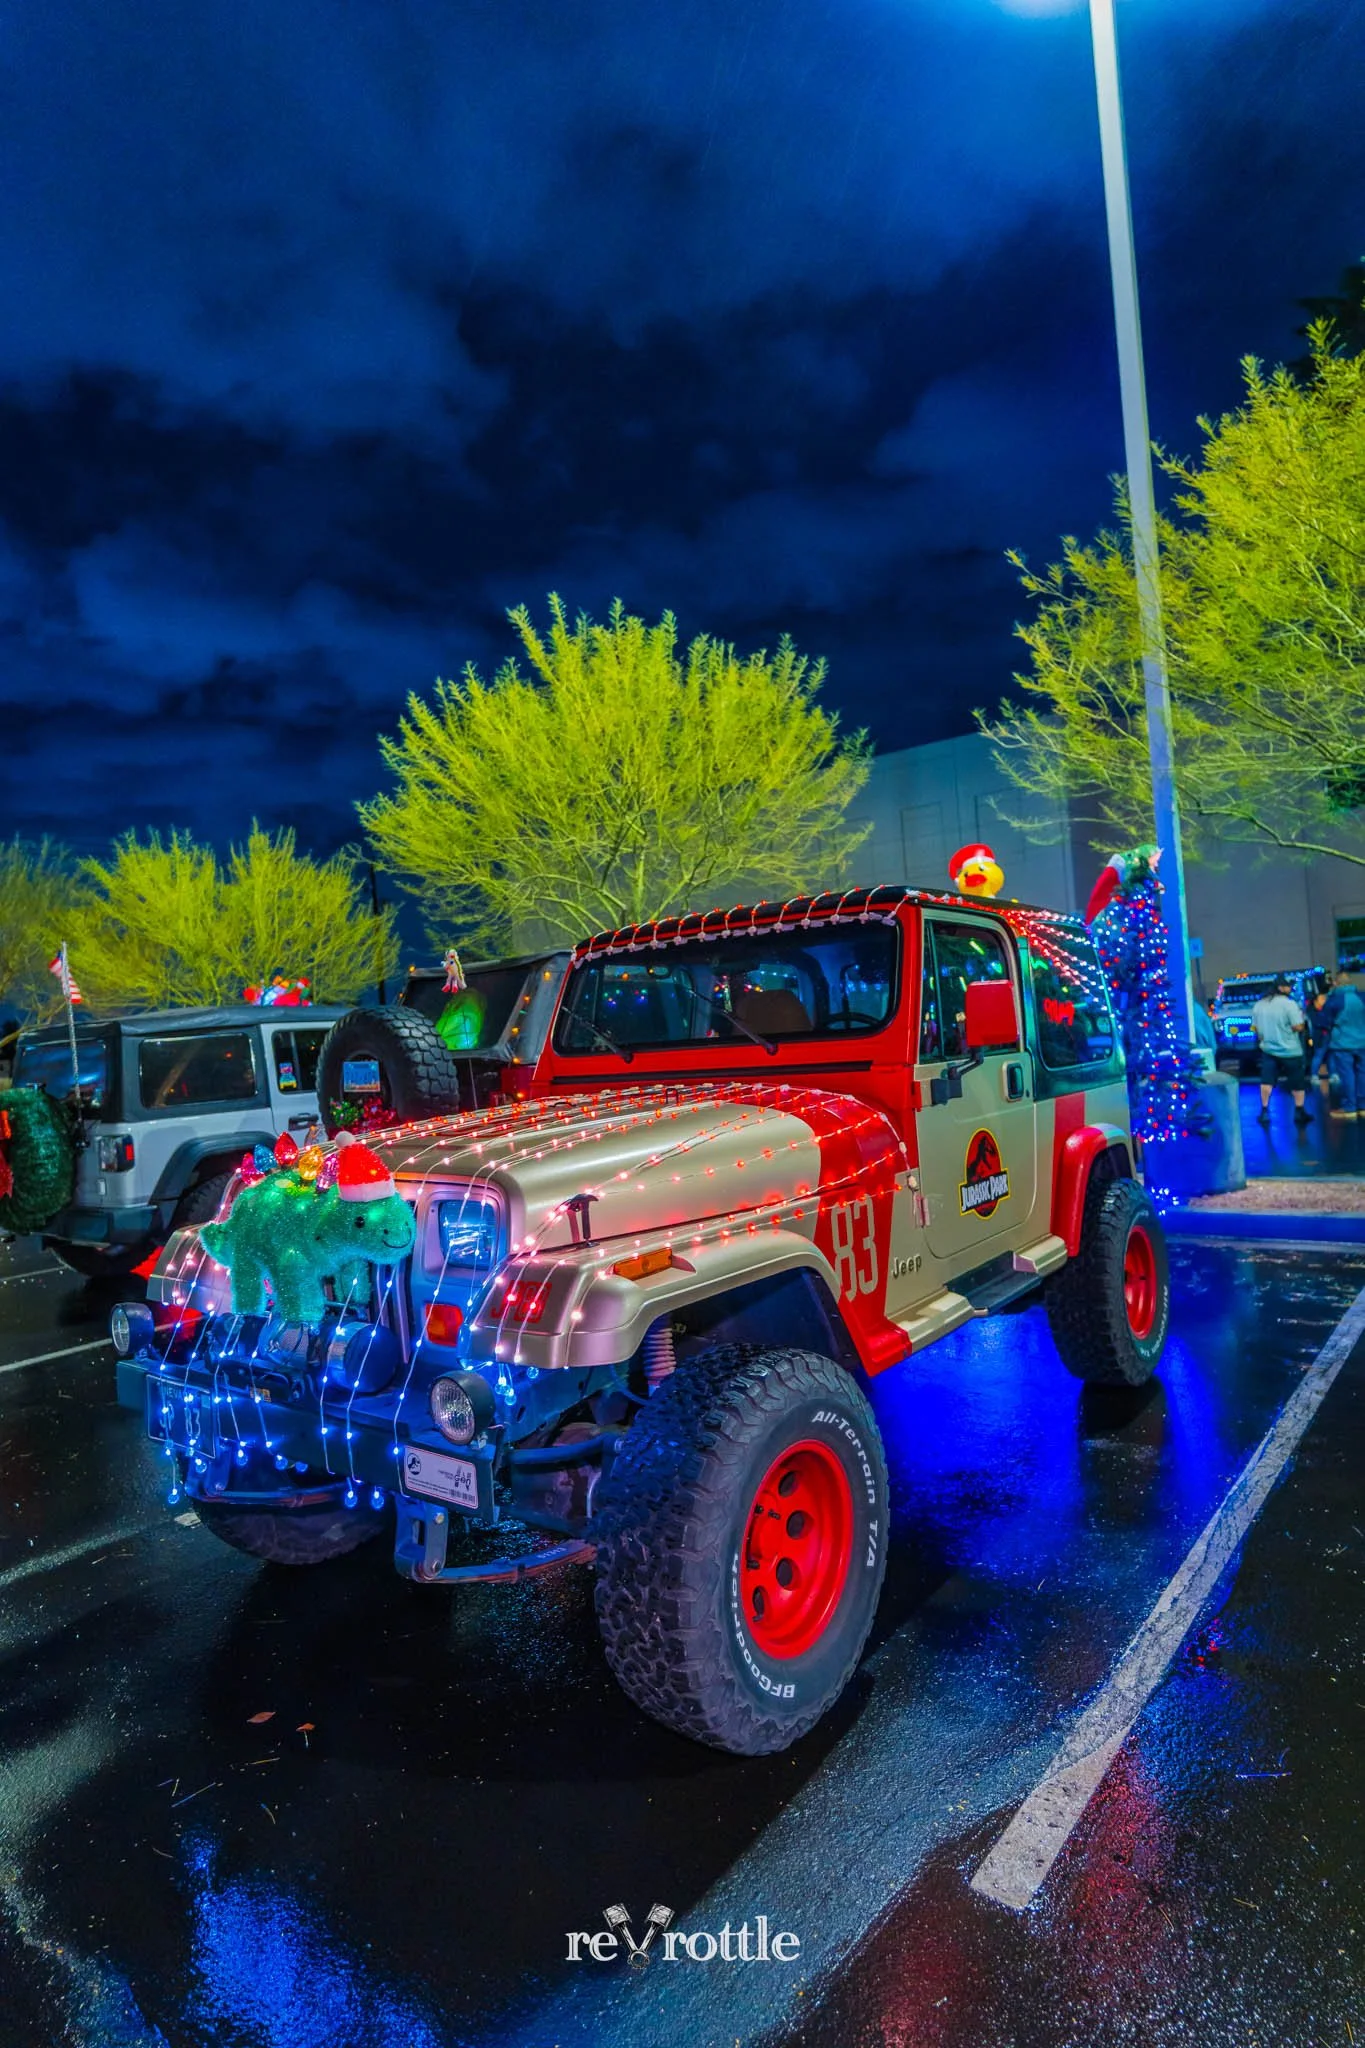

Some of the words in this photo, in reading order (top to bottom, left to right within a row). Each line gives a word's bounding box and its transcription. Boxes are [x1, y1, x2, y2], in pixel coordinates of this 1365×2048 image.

[961, 1180, 991, 1212] JURASSIC
[989, 1173, 1009, 1200] PARK
[830, 1193, 878, 1304] 83
[891, 1253, 923, 1279] Jeep
[811, 1410, 876, 1504] All-Terrain
[866, 1519, 878, 1568] T/A
[731, 1553, 796, 1698] BFGoodrich
